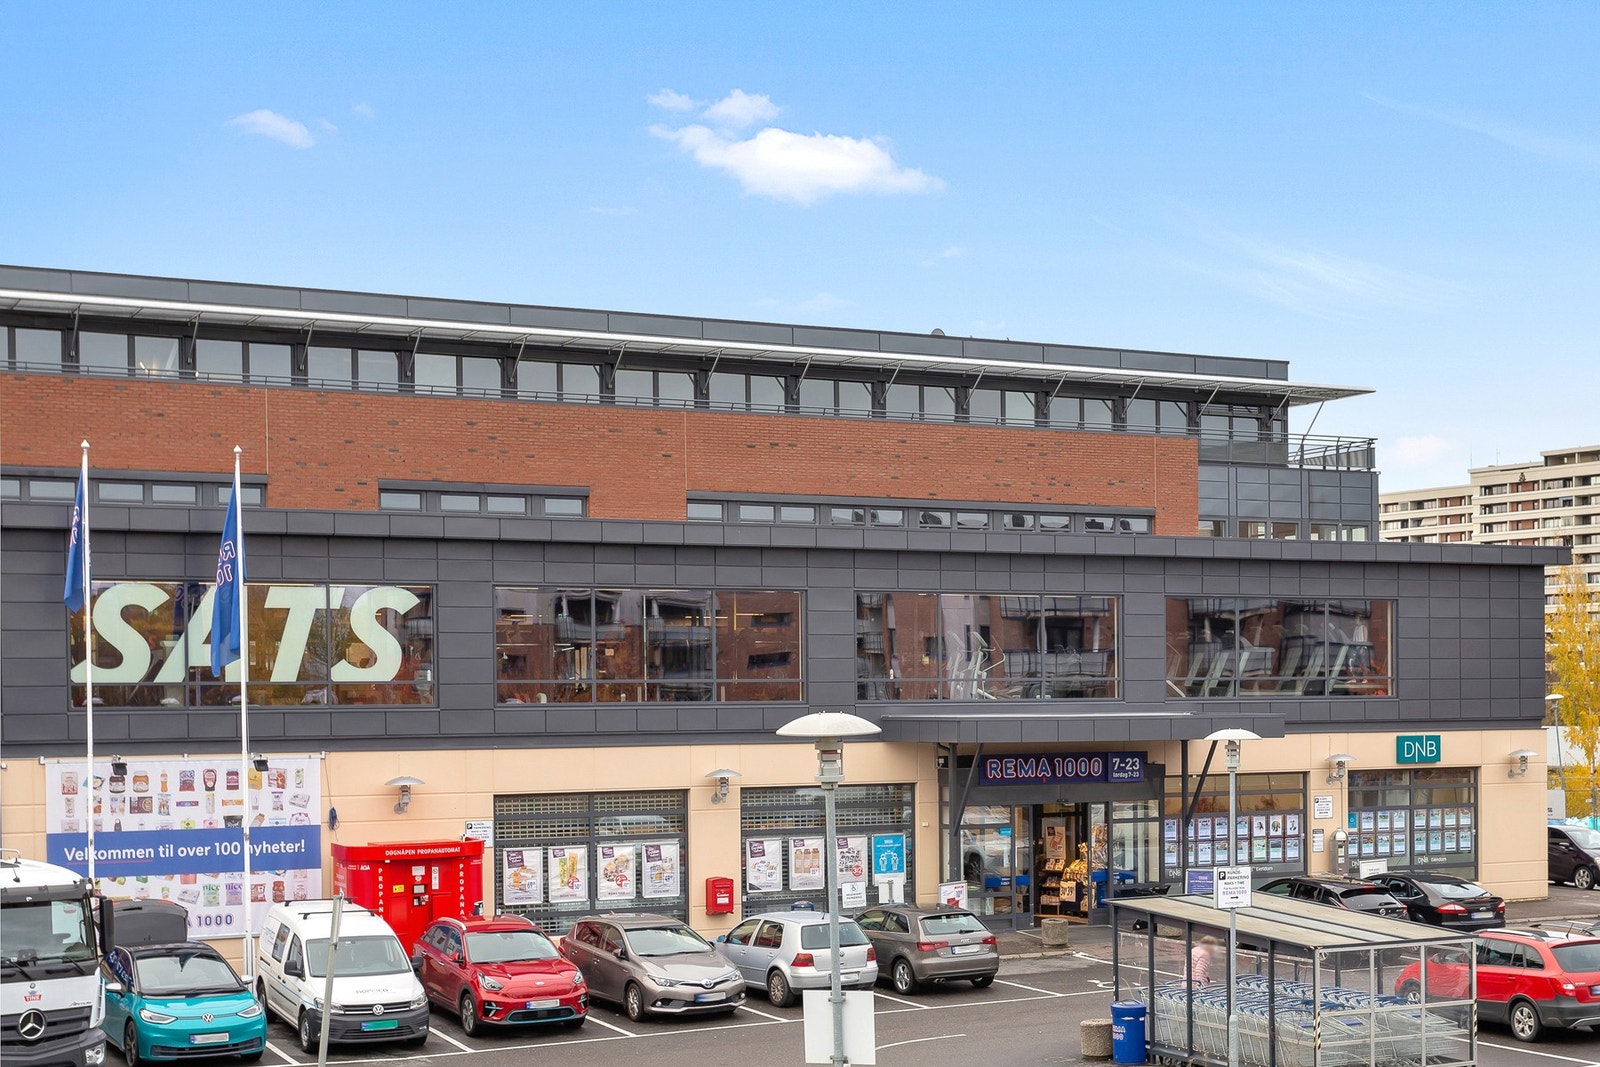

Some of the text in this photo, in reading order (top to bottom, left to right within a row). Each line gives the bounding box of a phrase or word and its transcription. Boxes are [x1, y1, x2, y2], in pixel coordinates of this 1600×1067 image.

[70, 583, 421, 684] SATS
[1404, 735, 1437, 763] DNB
[986, 757, 1103, 779] REMA 1000
[1112, 757, 1140, 770] 7-23
[64, 839, 305, 862] Velkommen til over 100 nyheter!
[417, 846, 461, 855] PROPANAUTOMAT
[197, 914, 234, 928] 1000
